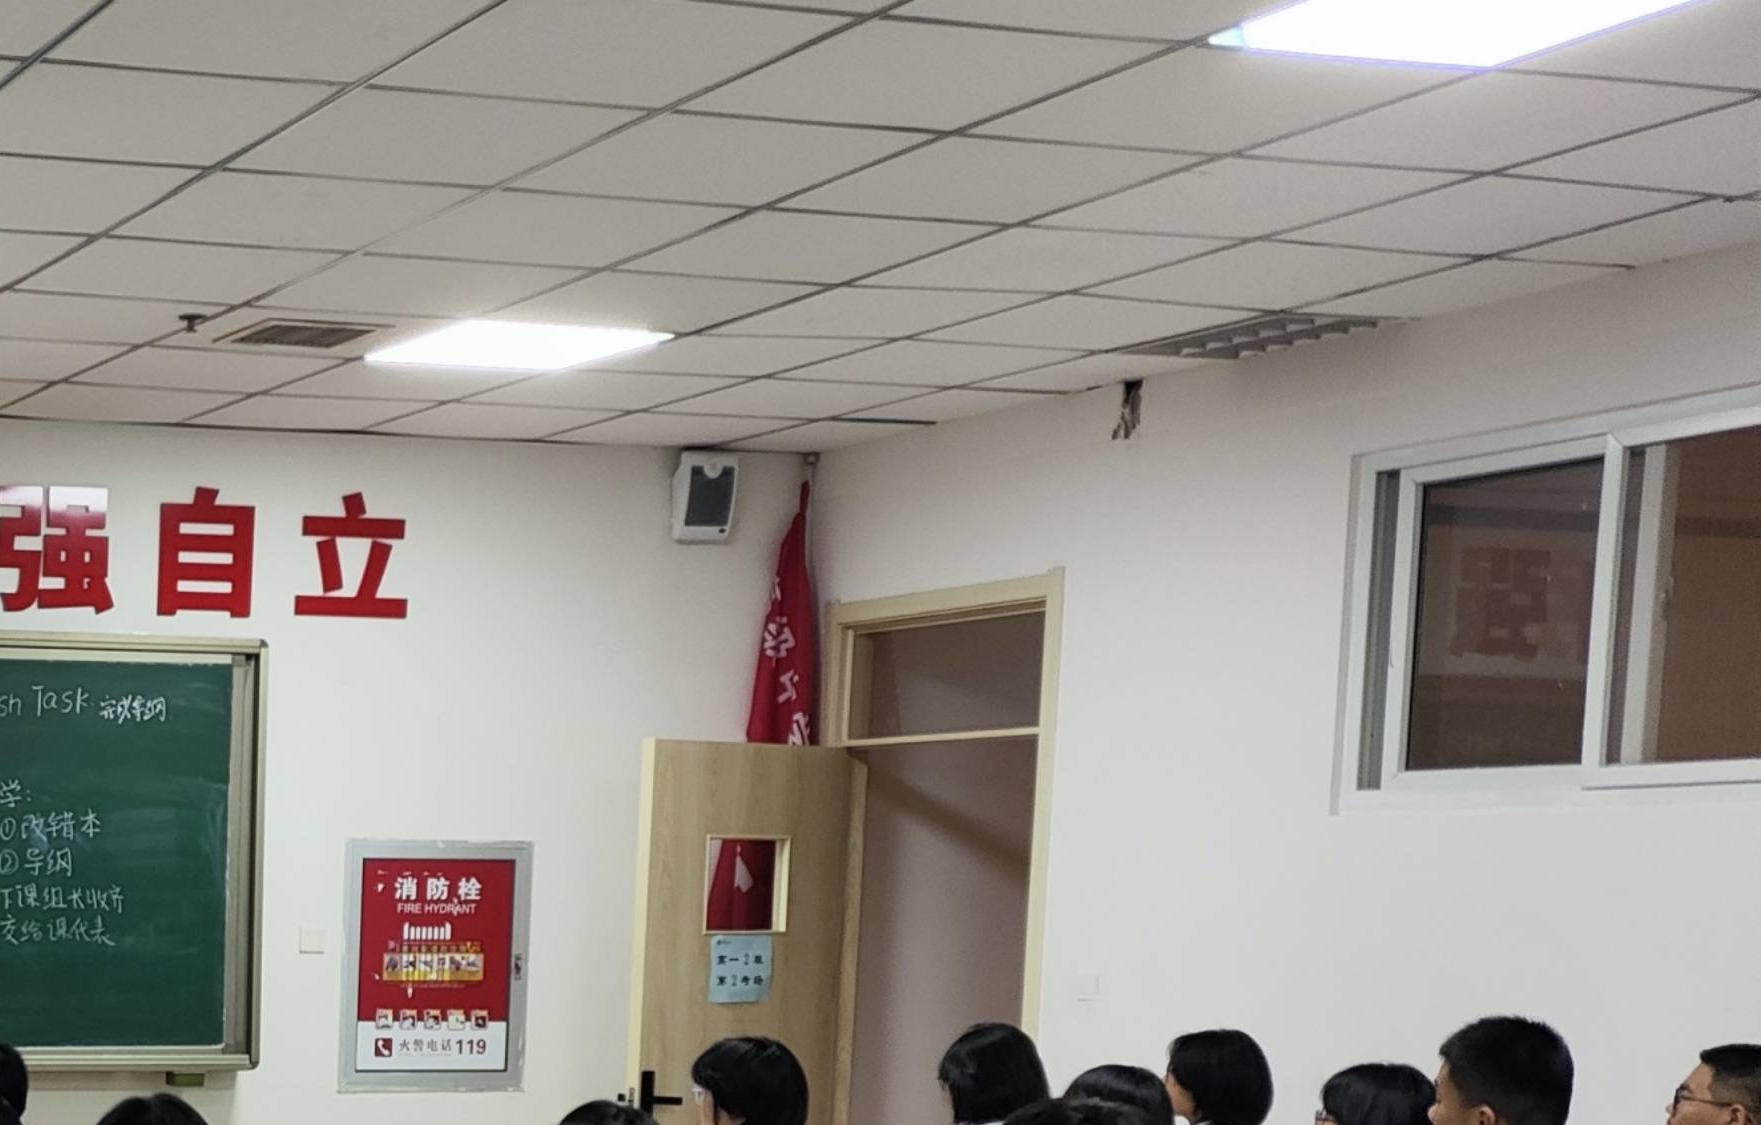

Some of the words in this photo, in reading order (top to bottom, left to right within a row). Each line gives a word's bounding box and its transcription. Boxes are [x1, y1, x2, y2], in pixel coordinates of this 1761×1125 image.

[32, 686, 89, 717] Task
[395, 876, 482, 901] 消防栓
[397, 902, 422, 914] FIRE
[424, 902, 477, 915] HYDRANT
[456, 1038, 487, 1055] 119
